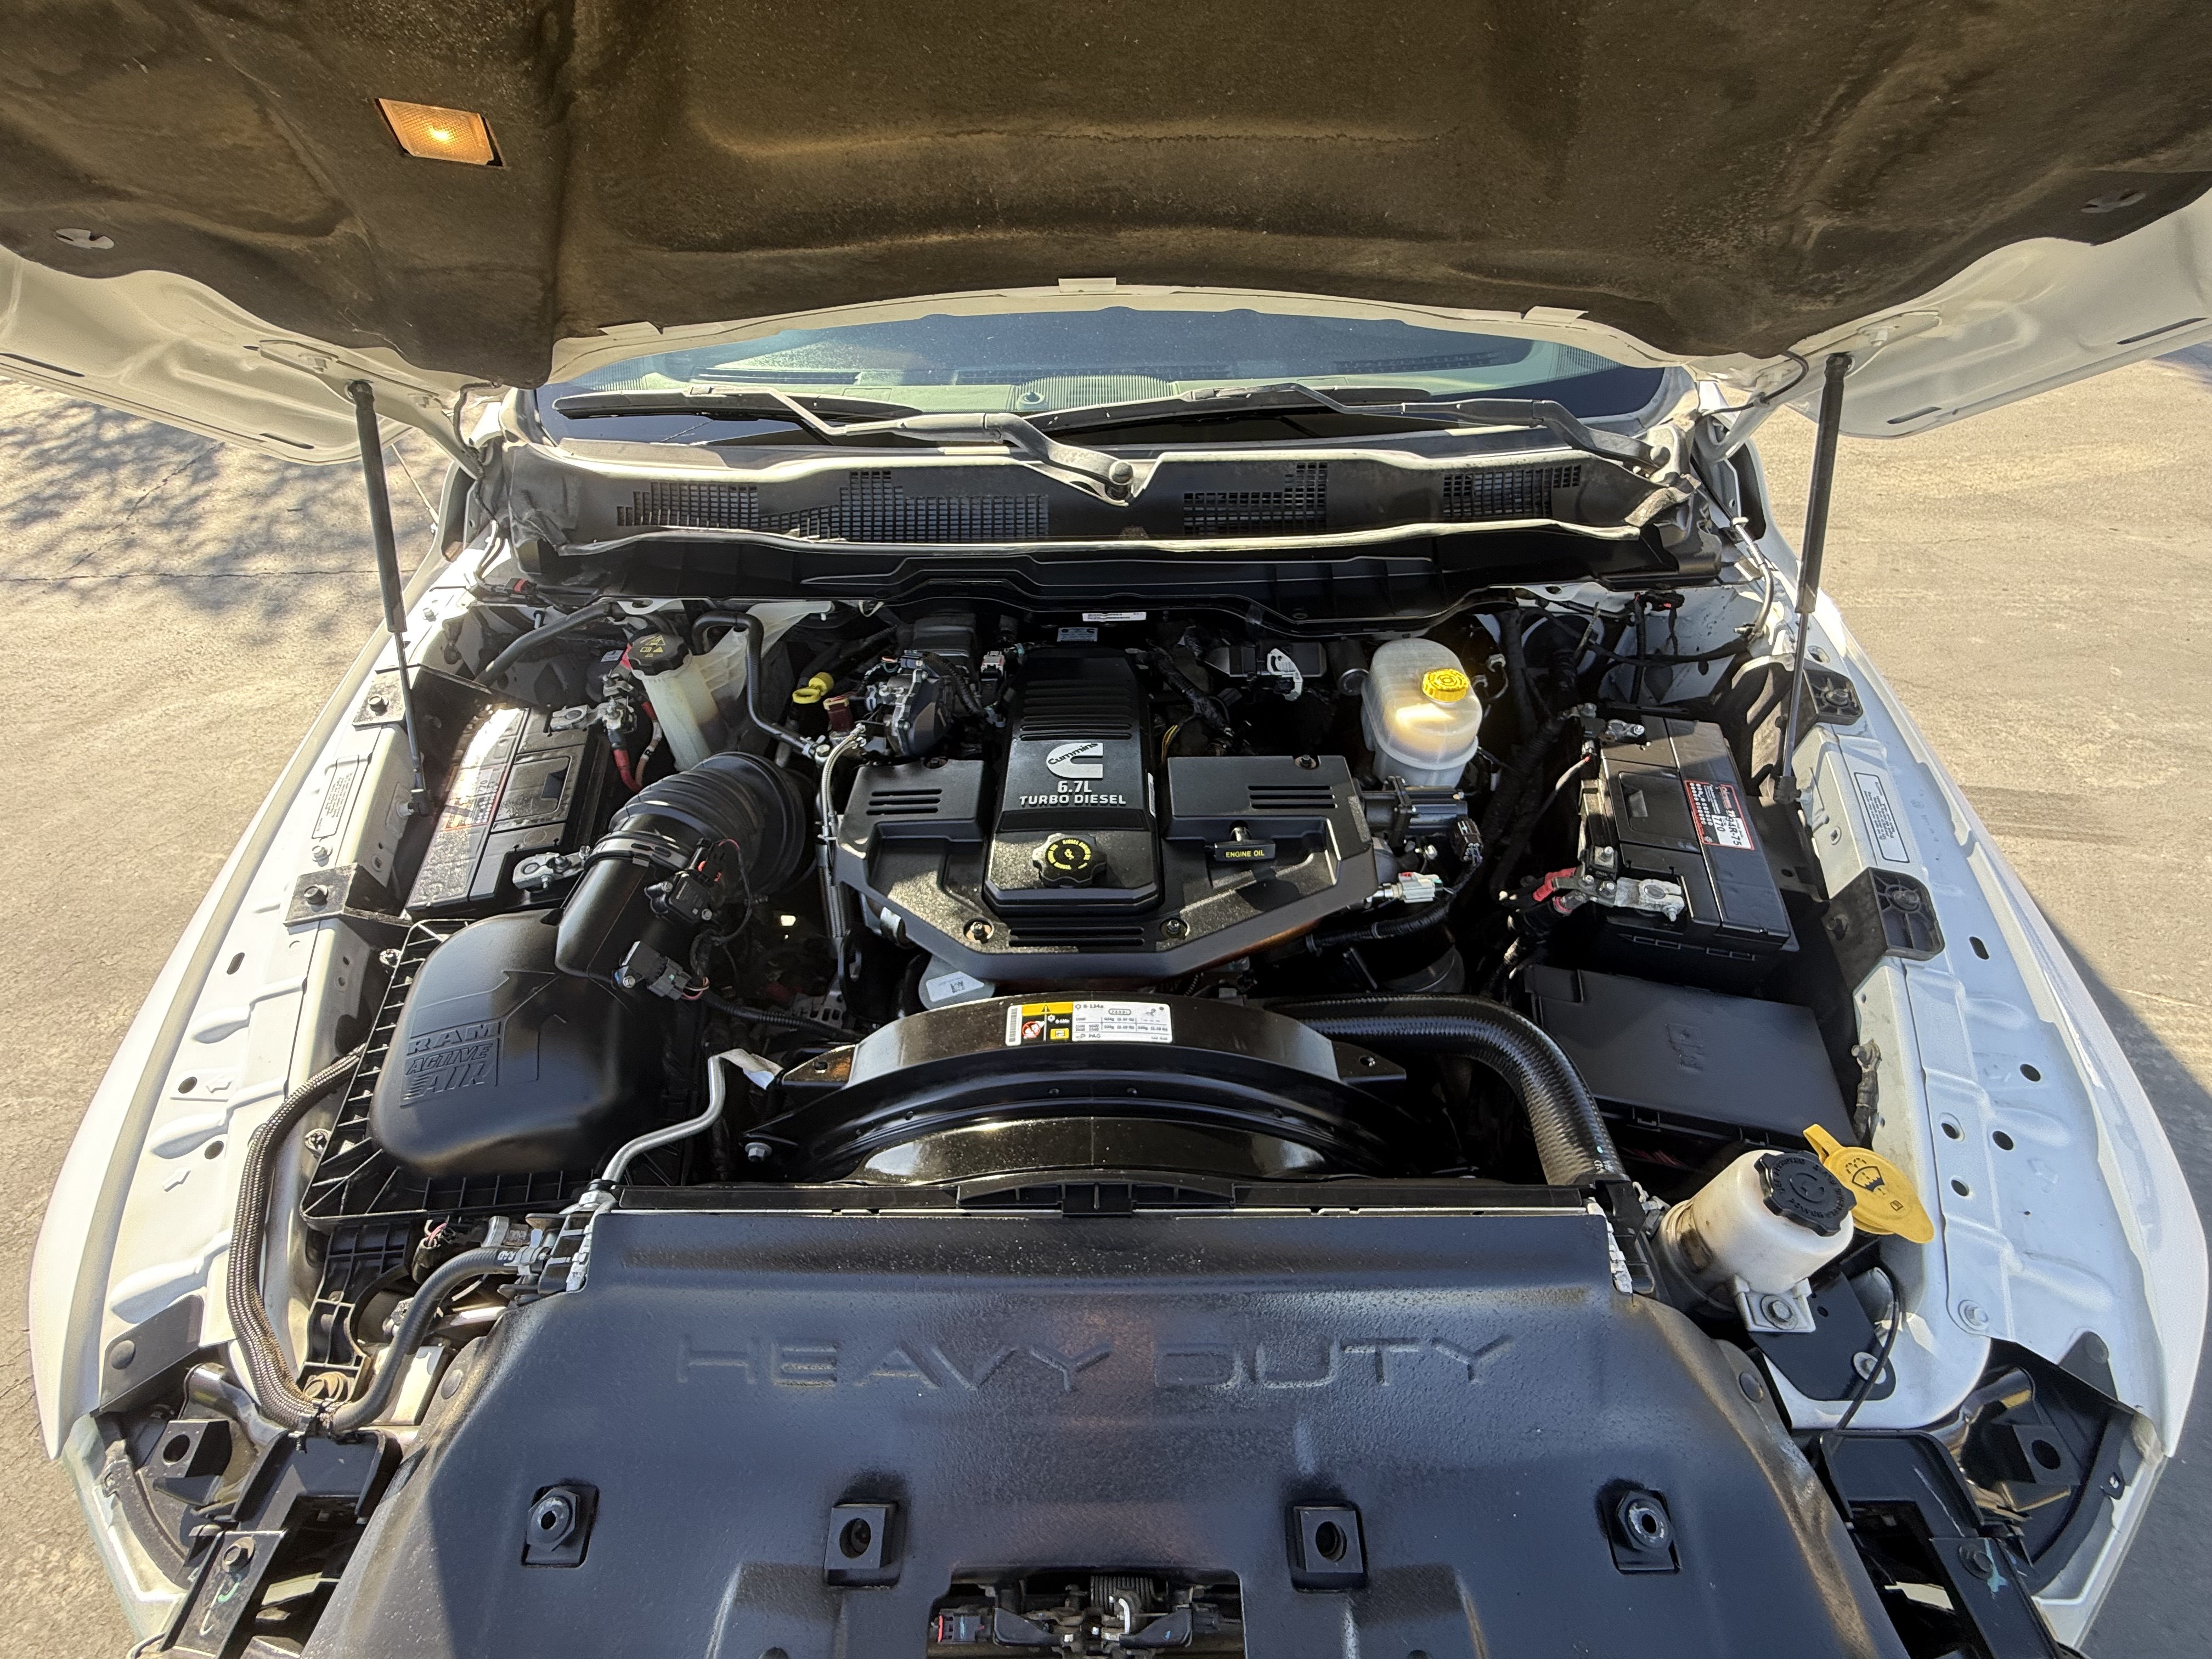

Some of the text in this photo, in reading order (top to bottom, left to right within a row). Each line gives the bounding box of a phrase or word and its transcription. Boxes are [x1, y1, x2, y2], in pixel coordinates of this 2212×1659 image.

[1048, 743, 1098, 765] Cummins
[1019, 794, 1126, 805] TURBO DIESEL
[1057, 780, 1092, 793] 6.7L
[1713, 817, 1725, 832] 770
[406, 1021, 502, 1056] RAM
[405, 1043, 493, 1076] ACTIVE
[413, 1061, 494, 1097] AIR
[676, 1333, 1515, 1392] HEAVY DUTY
